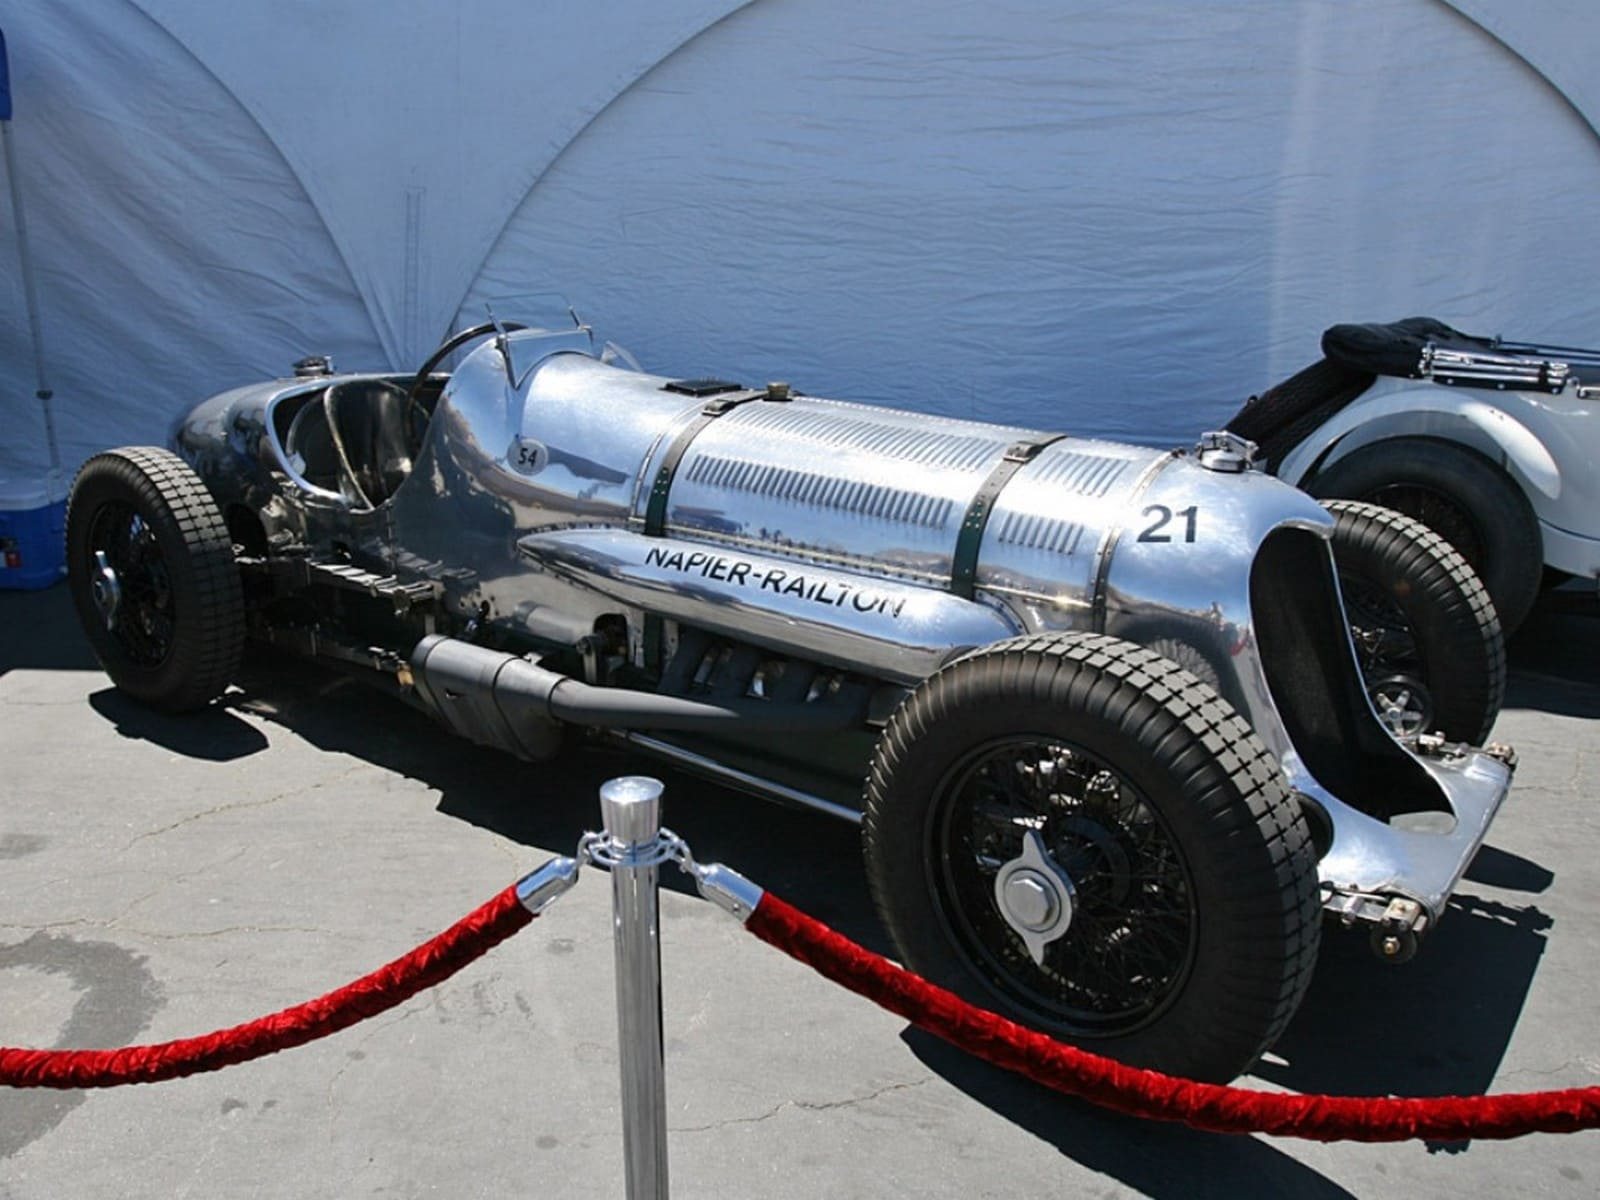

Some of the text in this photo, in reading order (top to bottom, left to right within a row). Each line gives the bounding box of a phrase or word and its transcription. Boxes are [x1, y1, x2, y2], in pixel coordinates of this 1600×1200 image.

[518, 447, 538, 467] 54
[1137, 504, 1198, 543] 21
[645, 547, 906, 619] NAPIER-RAILTON
